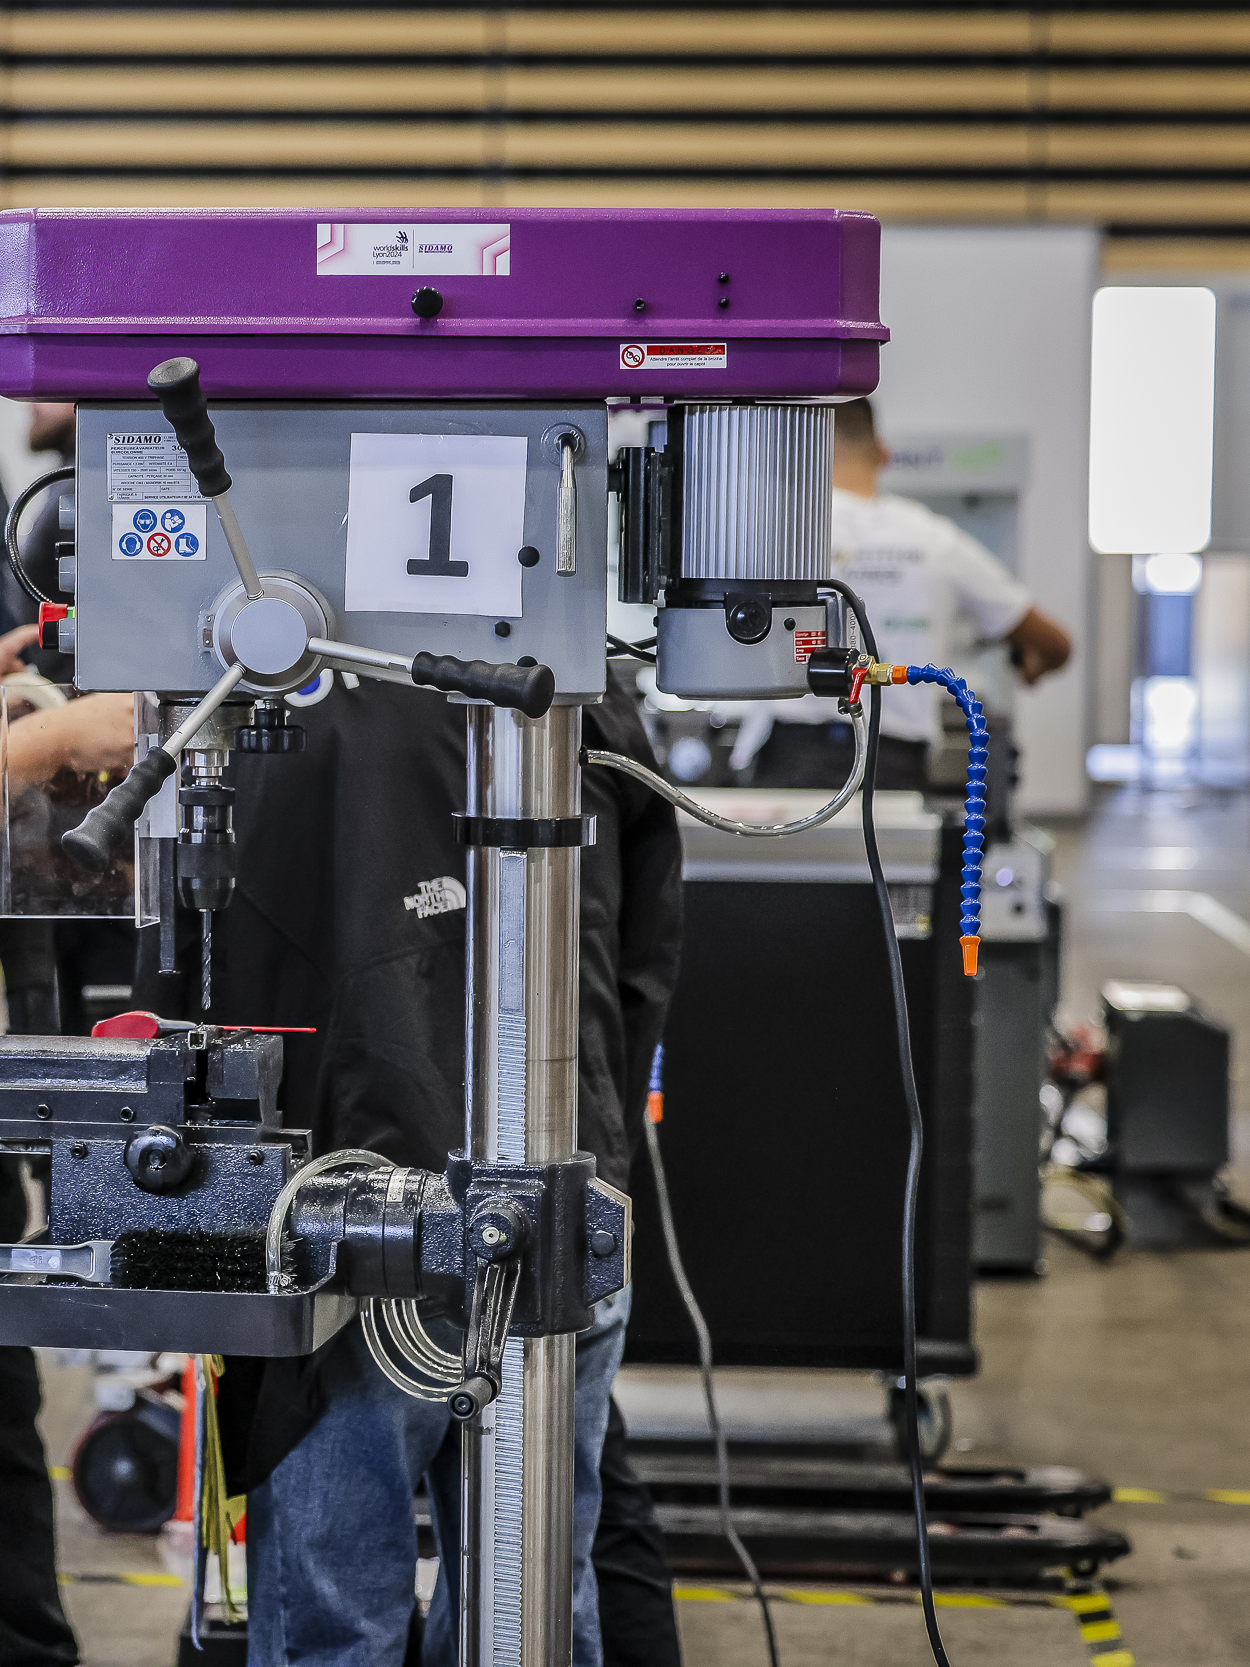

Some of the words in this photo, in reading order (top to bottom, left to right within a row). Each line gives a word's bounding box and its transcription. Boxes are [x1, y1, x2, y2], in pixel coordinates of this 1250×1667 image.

[372, 251, 402, 259] Lyon2024
[113, 435, 162, 444] SIDAMO
[406, 473, 469, 577] 1
[417, 879, 443, 895] THE
[403, 891, 447, 910] NORTH
[416, 900, 448, 918] FACE
